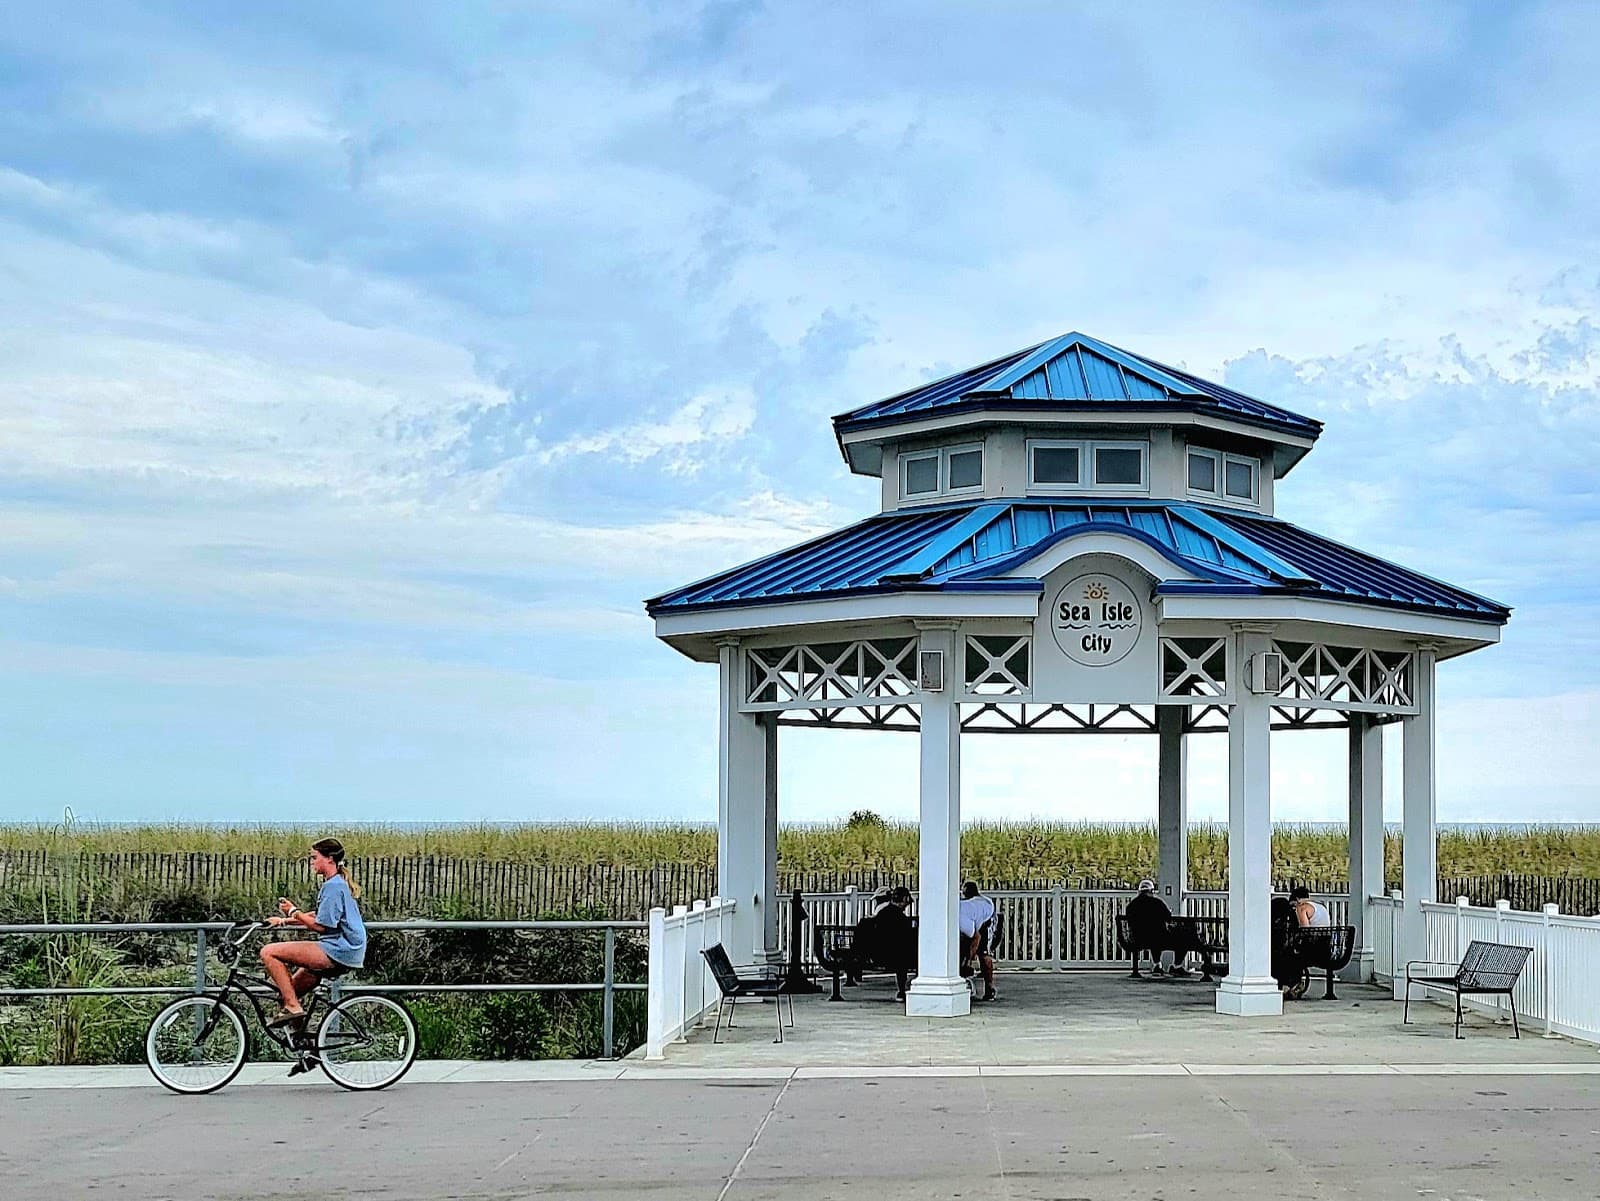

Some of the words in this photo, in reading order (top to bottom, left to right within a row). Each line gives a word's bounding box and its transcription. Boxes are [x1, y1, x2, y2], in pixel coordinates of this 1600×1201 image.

[1060, 602, 1090, 621] Sea
[1102, 602, 1133, 621] Isle
[1081, 633, 1112, 654] City
